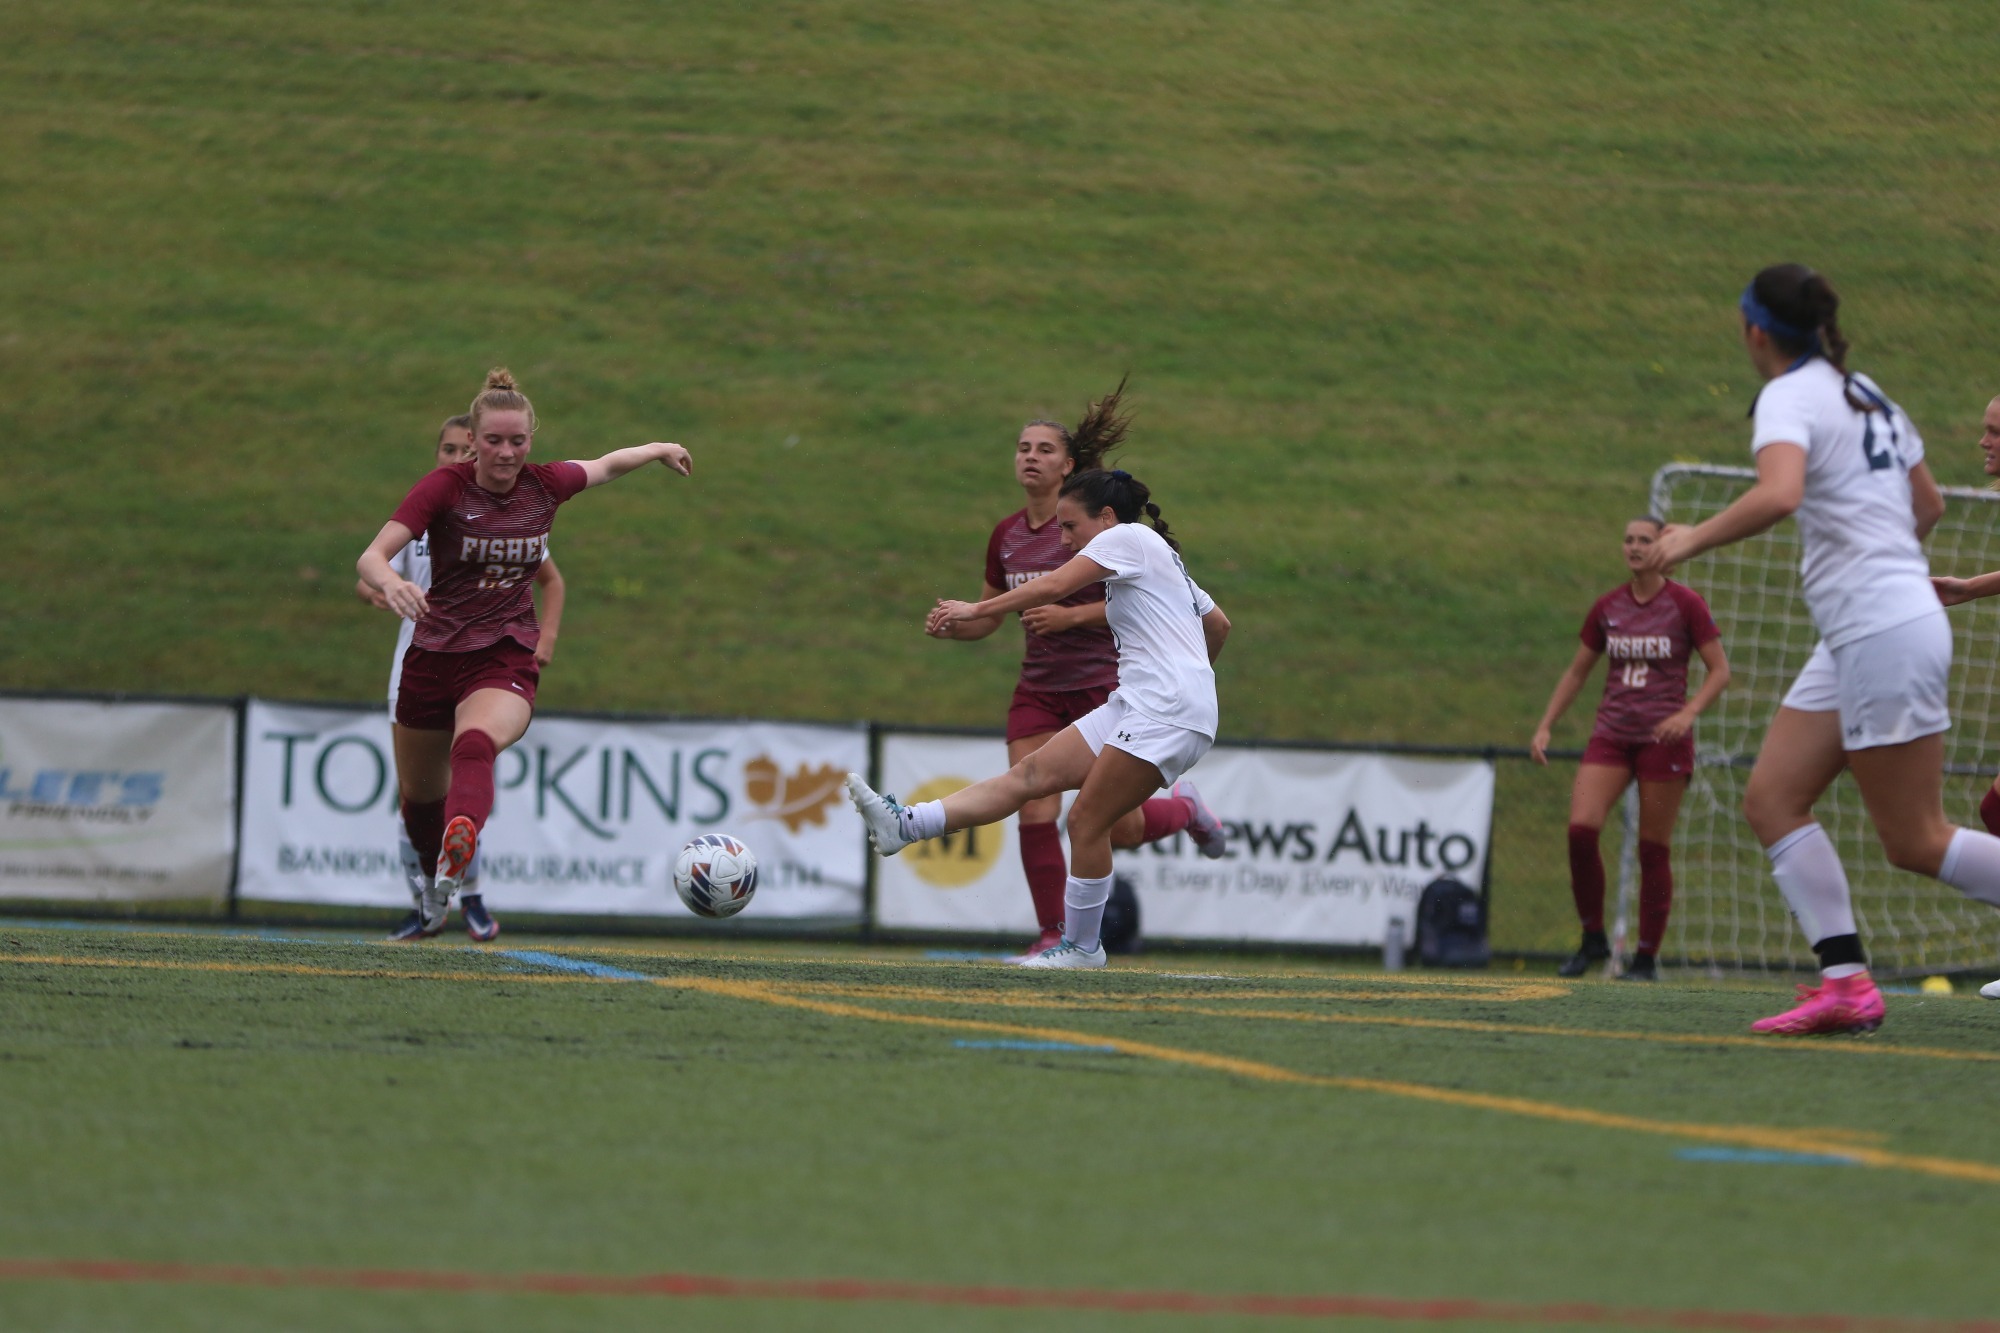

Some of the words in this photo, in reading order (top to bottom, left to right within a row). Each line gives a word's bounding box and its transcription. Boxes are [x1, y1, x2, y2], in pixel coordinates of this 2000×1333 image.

[1622, 661, 1649, 687] 12
[264, 732, 732, 839] TOPKINS
[1326, 804, 1475, 870] Auto
[277, 845, 401, 876] BANKIN
[480, 853, 648, 888] NSURANCE
